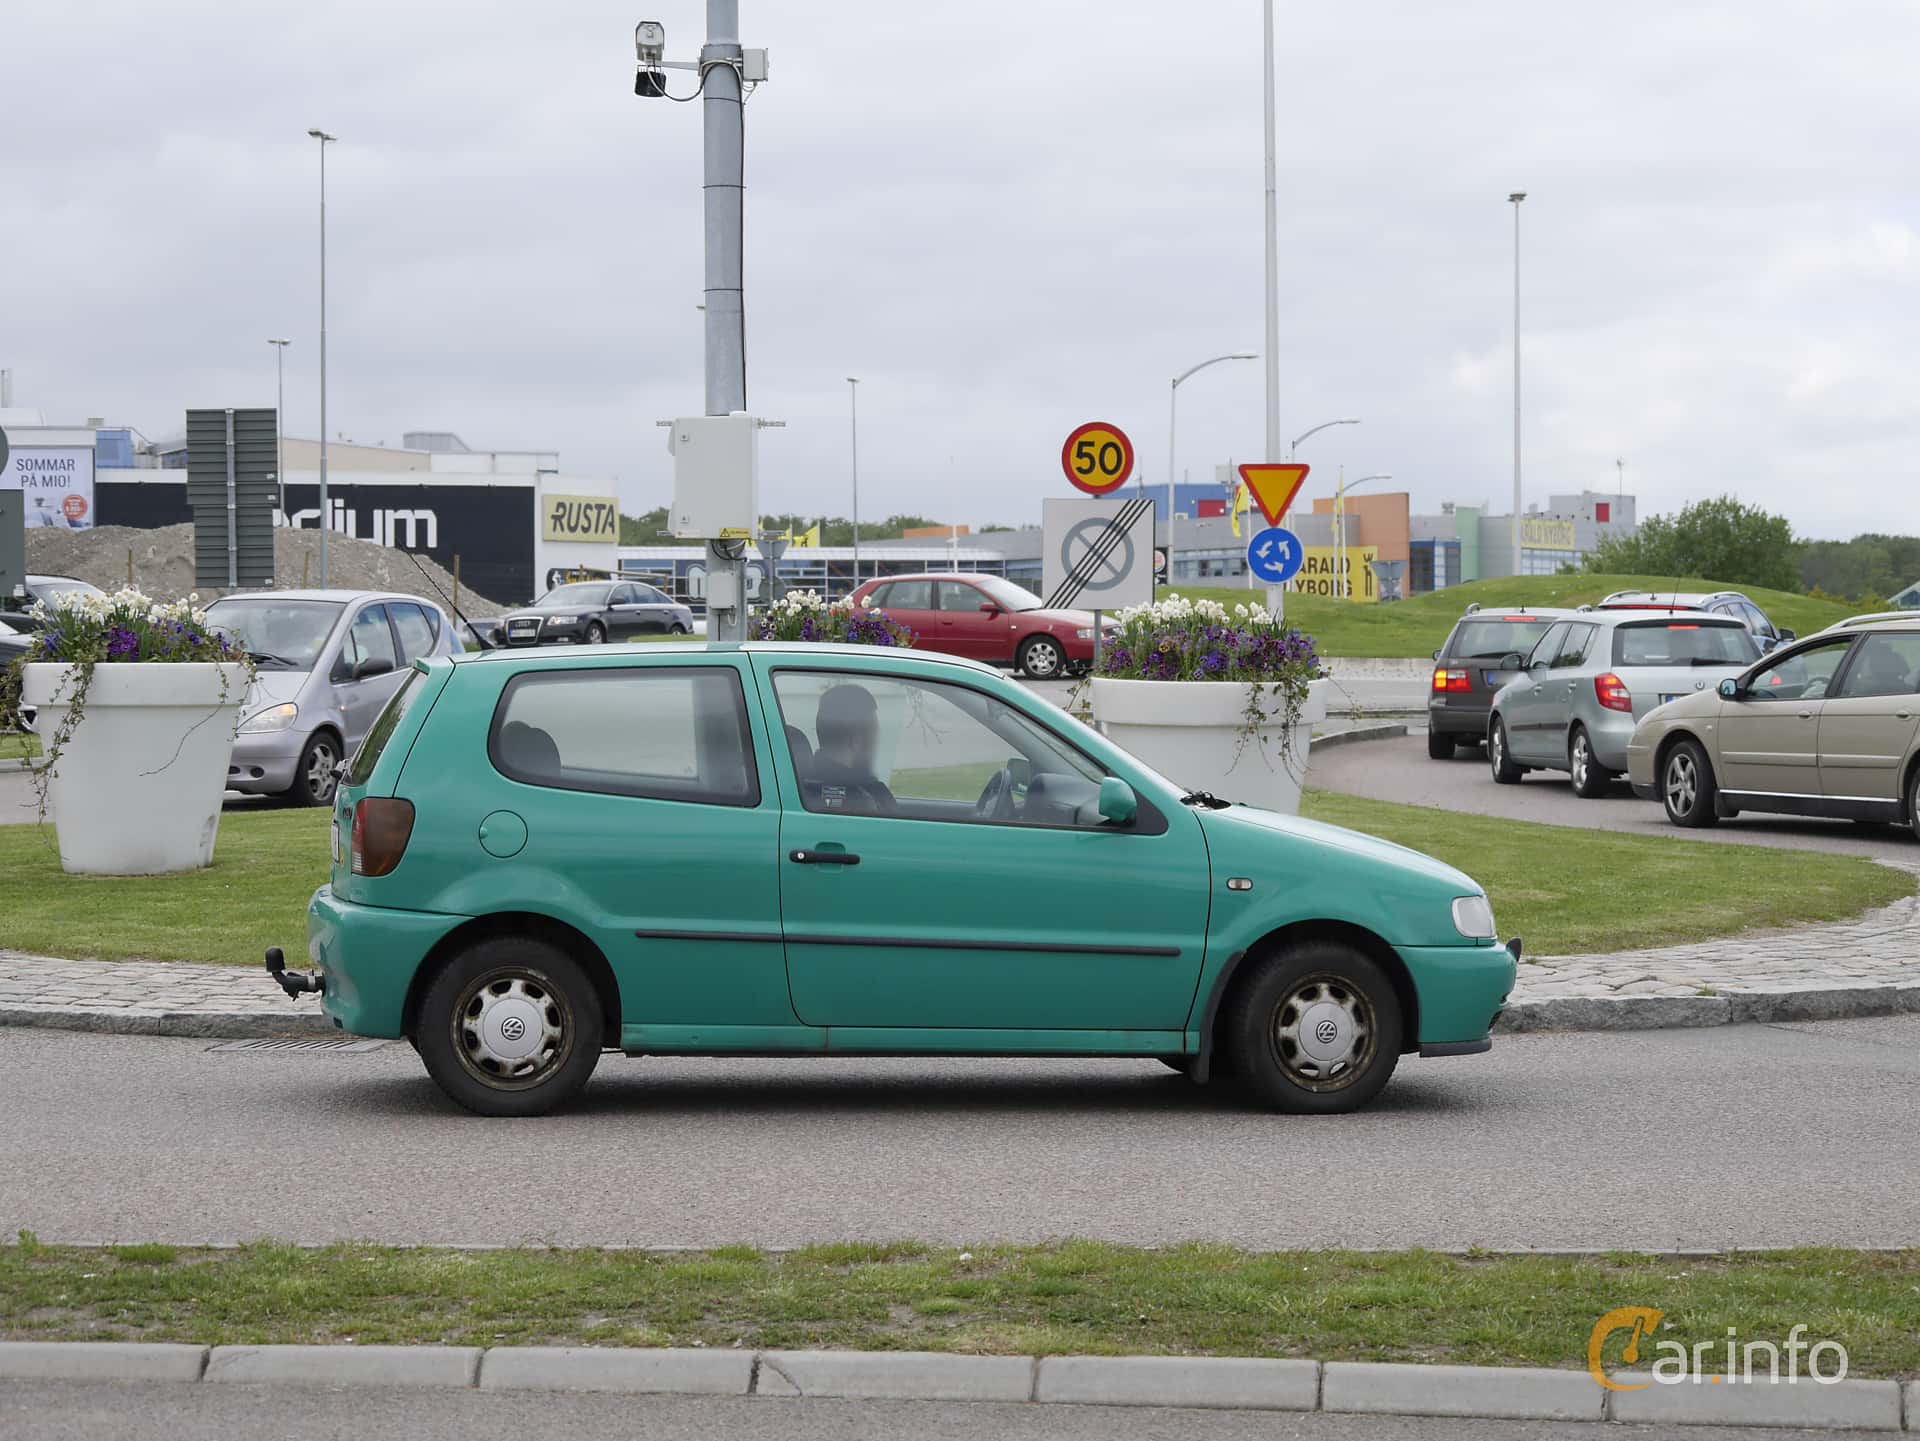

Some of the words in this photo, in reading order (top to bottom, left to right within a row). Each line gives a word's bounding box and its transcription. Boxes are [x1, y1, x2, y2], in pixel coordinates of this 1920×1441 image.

[16, 458, 76, 472] SOMMAR
[1075, 441, 1123, 476] 50
[21, 472, 38, 488] PÅ
[42, 475, 71, 488] MIO!
[551, 501, 616, 535] RUSTA
[1299, 556, 1351, 575] ARALD
